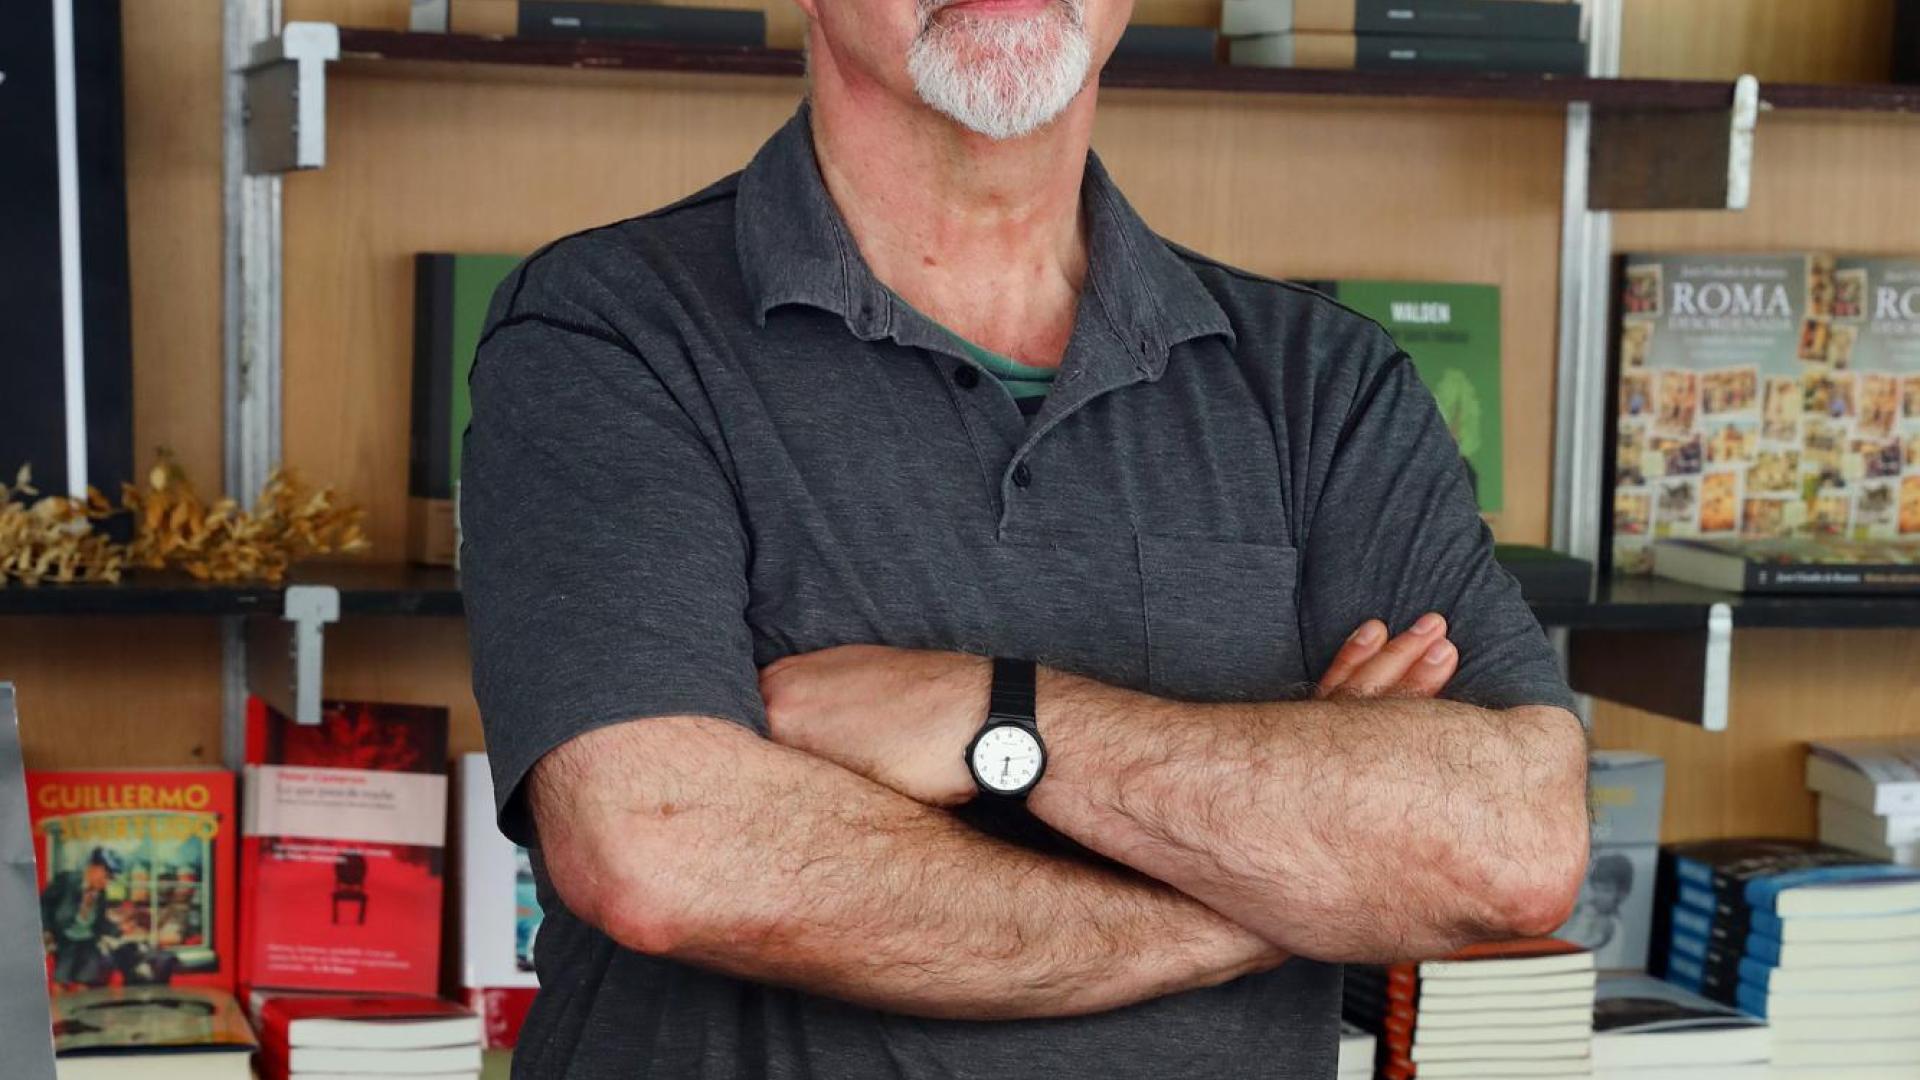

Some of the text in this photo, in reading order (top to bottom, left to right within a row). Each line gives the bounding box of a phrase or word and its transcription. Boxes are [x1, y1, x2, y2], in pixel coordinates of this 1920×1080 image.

[1672, 281, 1791, 316] ROMA
[1390, 302, 1451, 323] WALDEN
[38, 784, 209, 808] GUILLERMO
